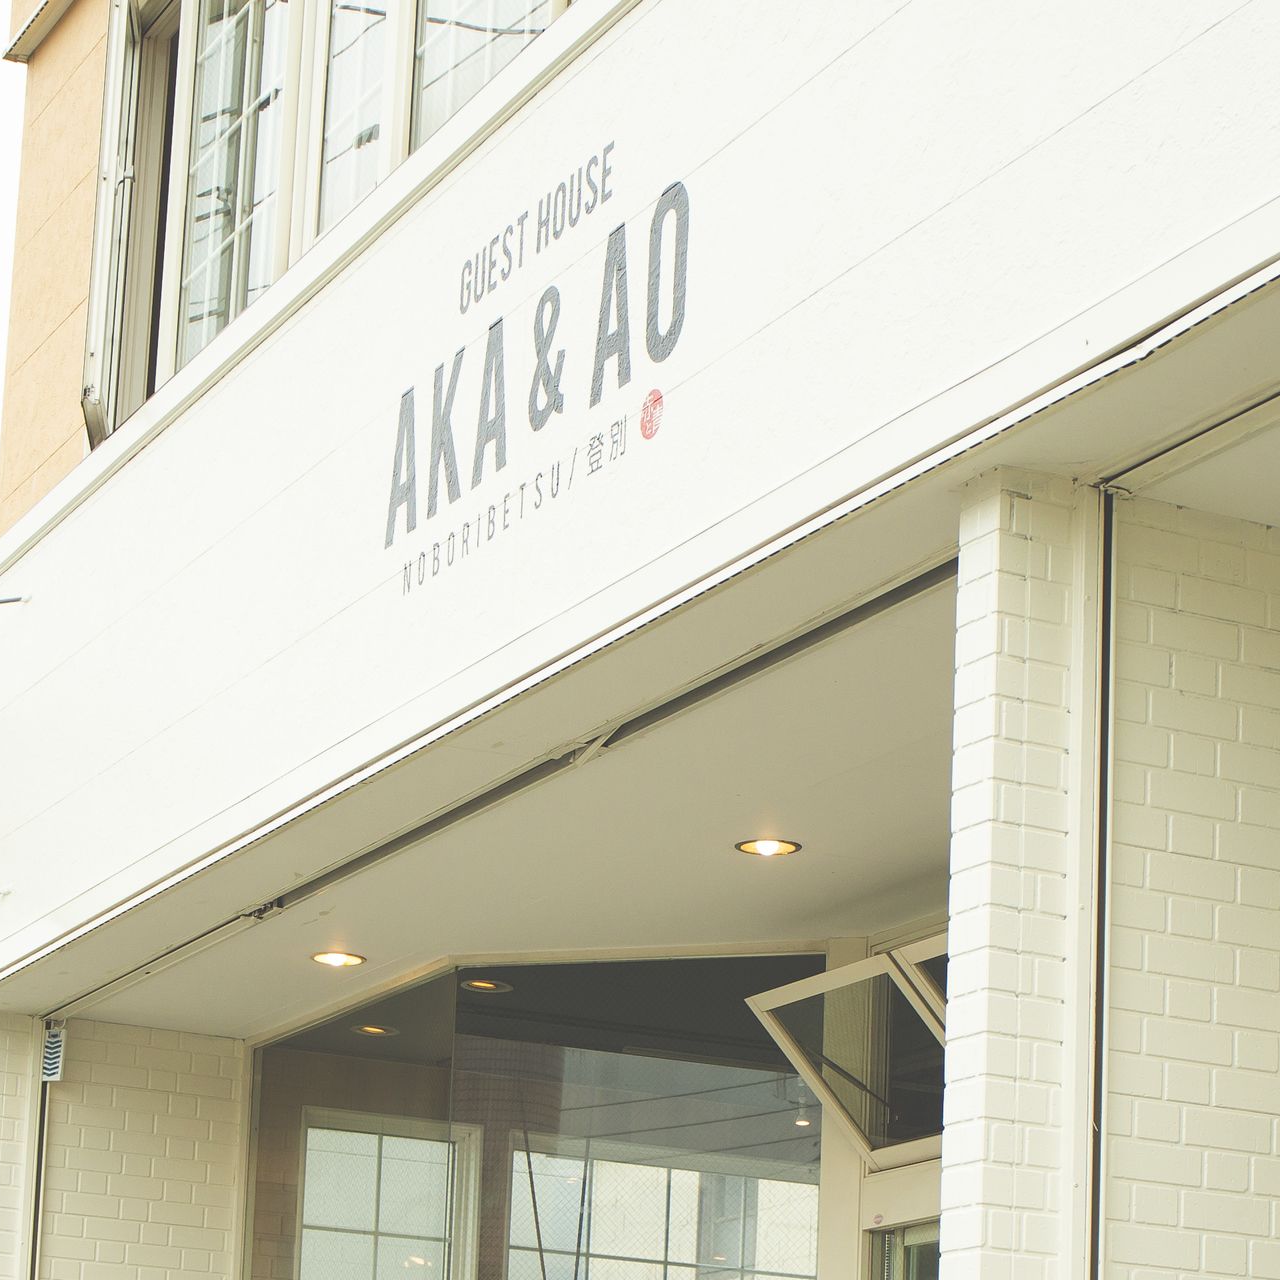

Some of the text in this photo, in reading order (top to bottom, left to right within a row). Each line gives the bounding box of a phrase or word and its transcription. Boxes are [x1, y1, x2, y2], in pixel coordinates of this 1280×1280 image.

[460, 140, 615, 315] GUEST HOUSE
[385, 181, 690, 550] AKA & AO
